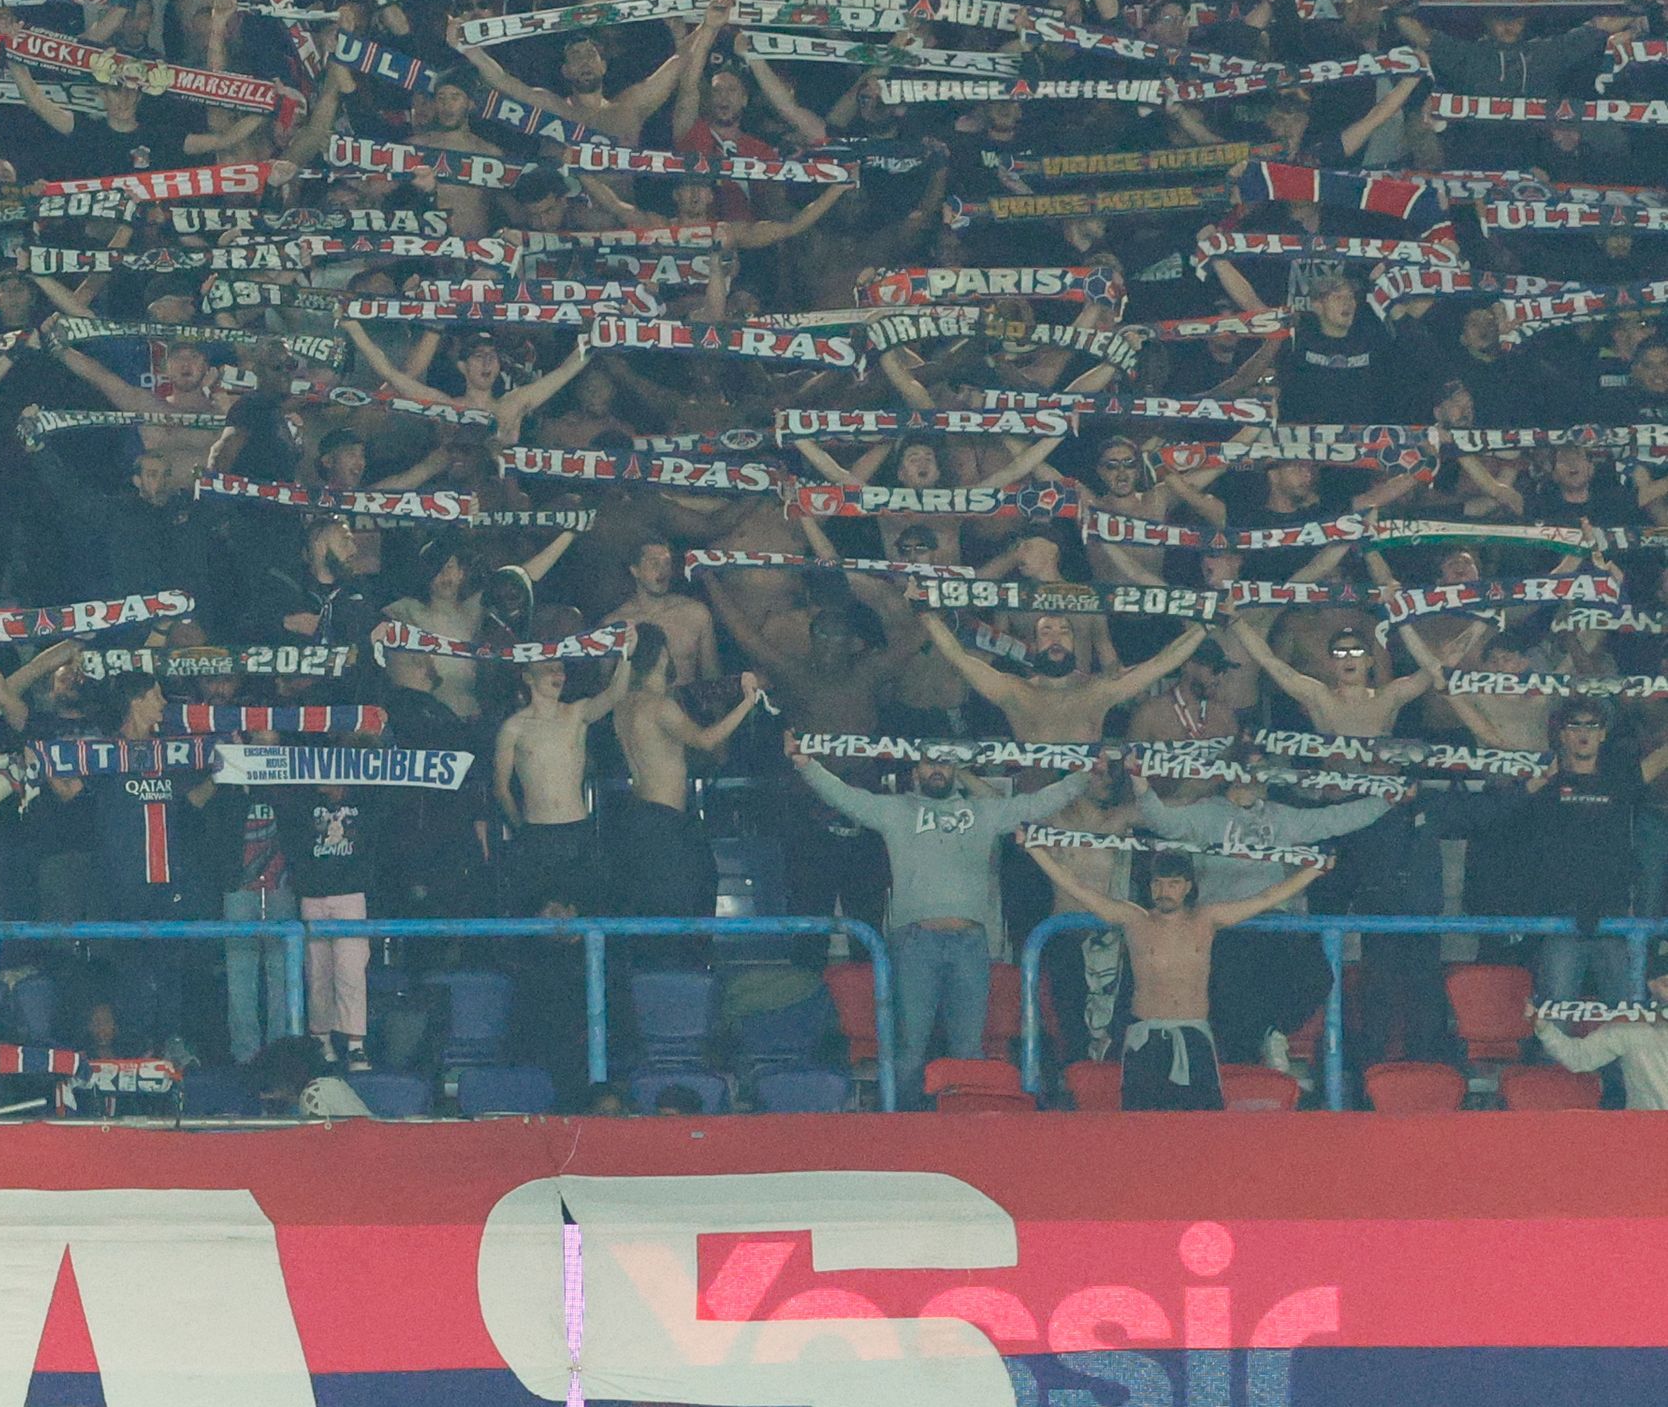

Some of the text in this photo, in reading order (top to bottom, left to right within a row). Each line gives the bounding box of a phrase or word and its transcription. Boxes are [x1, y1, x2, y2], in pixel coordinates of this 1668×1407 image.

[12, 36, 277, 106] FUCK! MARSEILLE
[879, 78, 1008, 105] VIRAGE
[931, 268, 1062, 296] PARIS
[868, 311, 979, 350] VIRAGE
[864, 487, 1002, 513] PARIS
[924, 580, 1220, 621] 1991 2021
[289, 748, 456, 786] INVINCIBLES
[126, 780, 172, 793] QATAR
